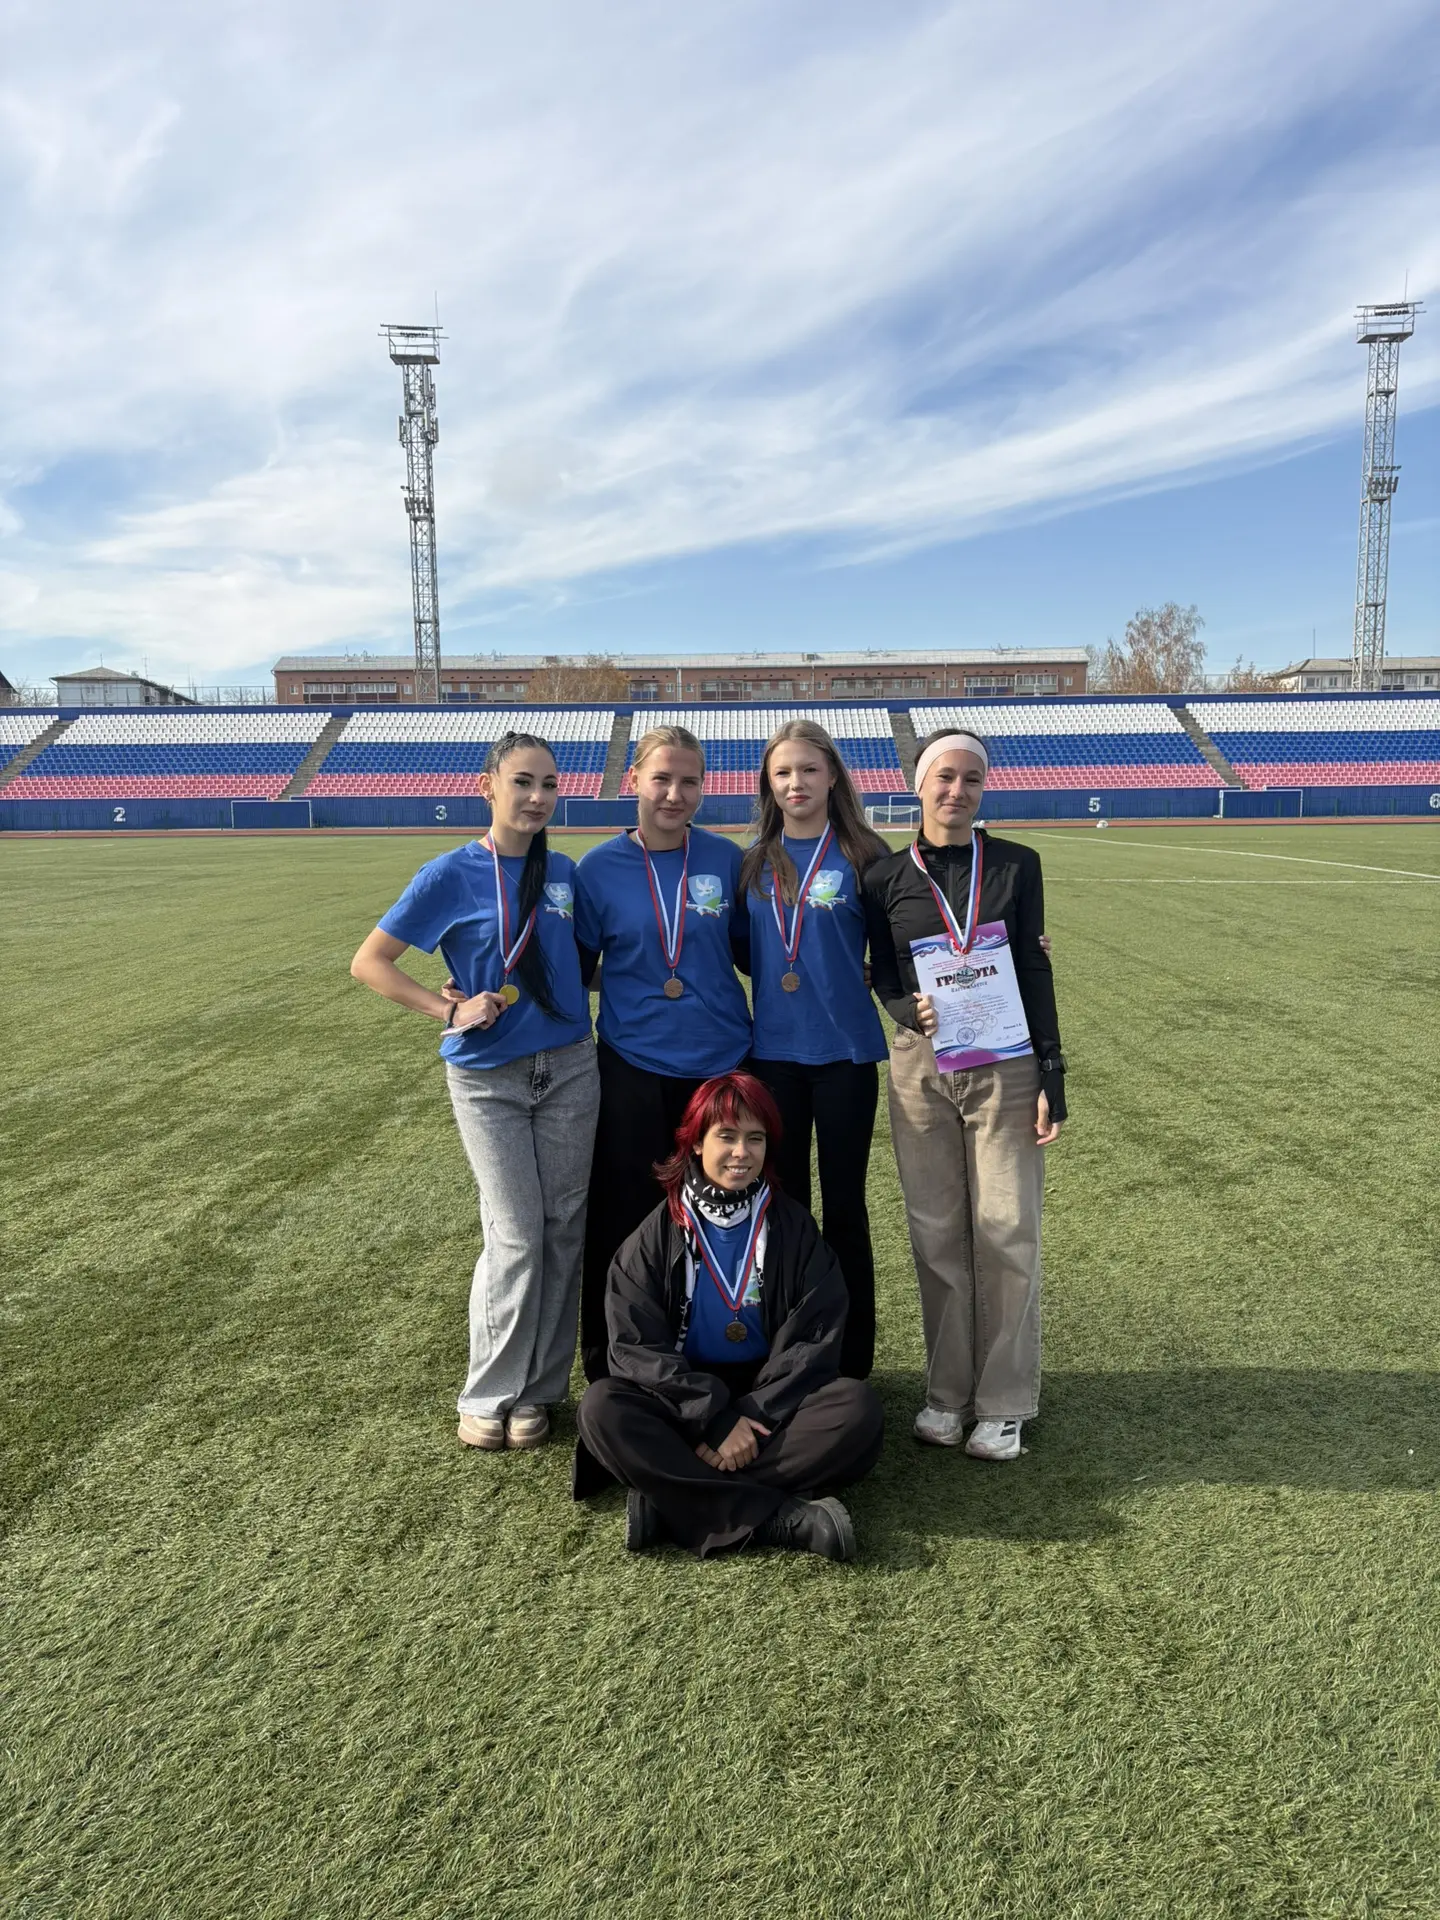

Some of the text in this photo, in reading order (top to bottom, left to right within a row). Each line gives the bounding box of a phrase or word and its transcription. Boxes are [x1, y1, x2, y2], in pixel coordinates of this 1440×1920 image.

[1088, 797, 1102, 812] 5
[1429, 793, 1440, 809] 6
[113, 807, 126, 822] 2
[435, 805, 448, 820] 3
